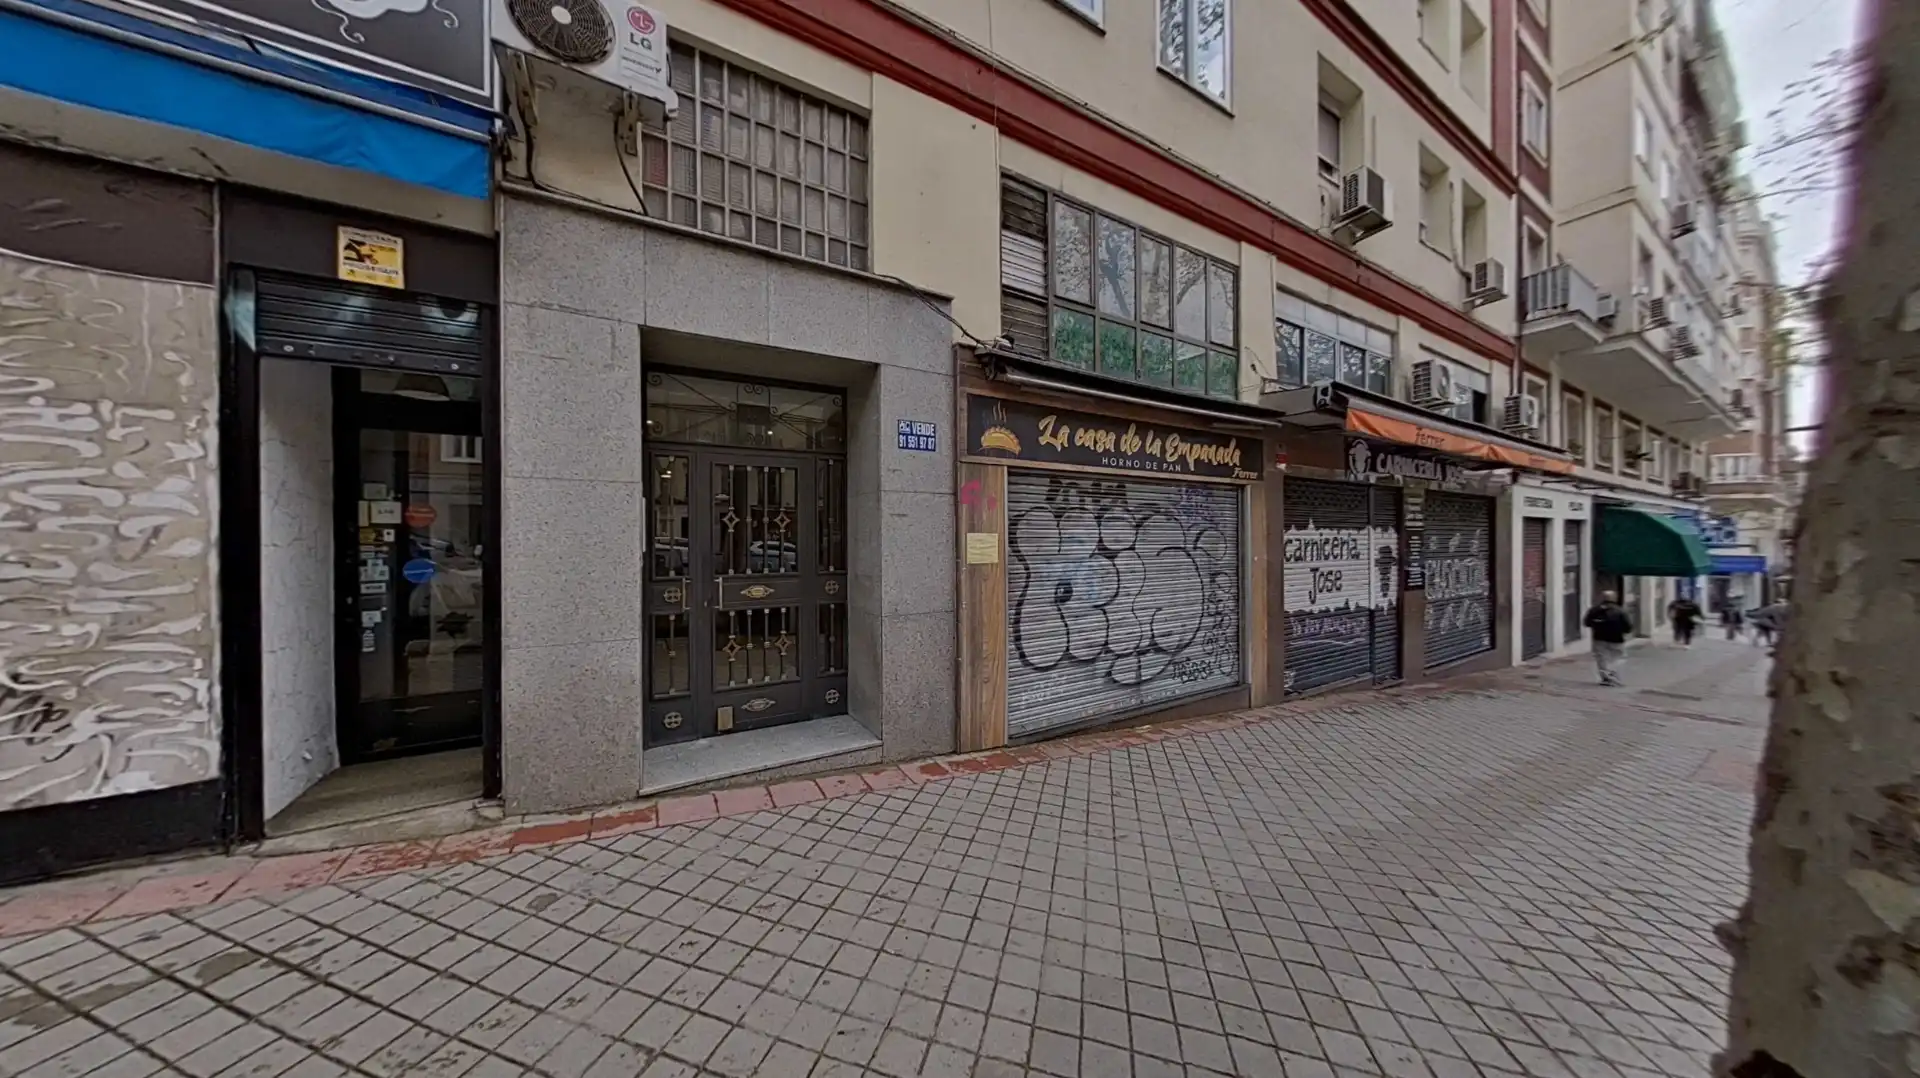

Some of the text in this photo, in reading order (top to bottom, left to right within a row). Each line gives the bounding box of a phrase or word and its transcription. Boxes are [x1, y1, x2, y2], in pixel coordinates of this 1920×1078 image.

[629, 31, 652, 51] LG
[911, 422, 935, 436] VENDE
[1038, 415, 1242, 471] La casa de la Empanada
[1102, 456, 1182, 472] HORNO DE PAN
[1308, 567, 1343, 605] Jose
